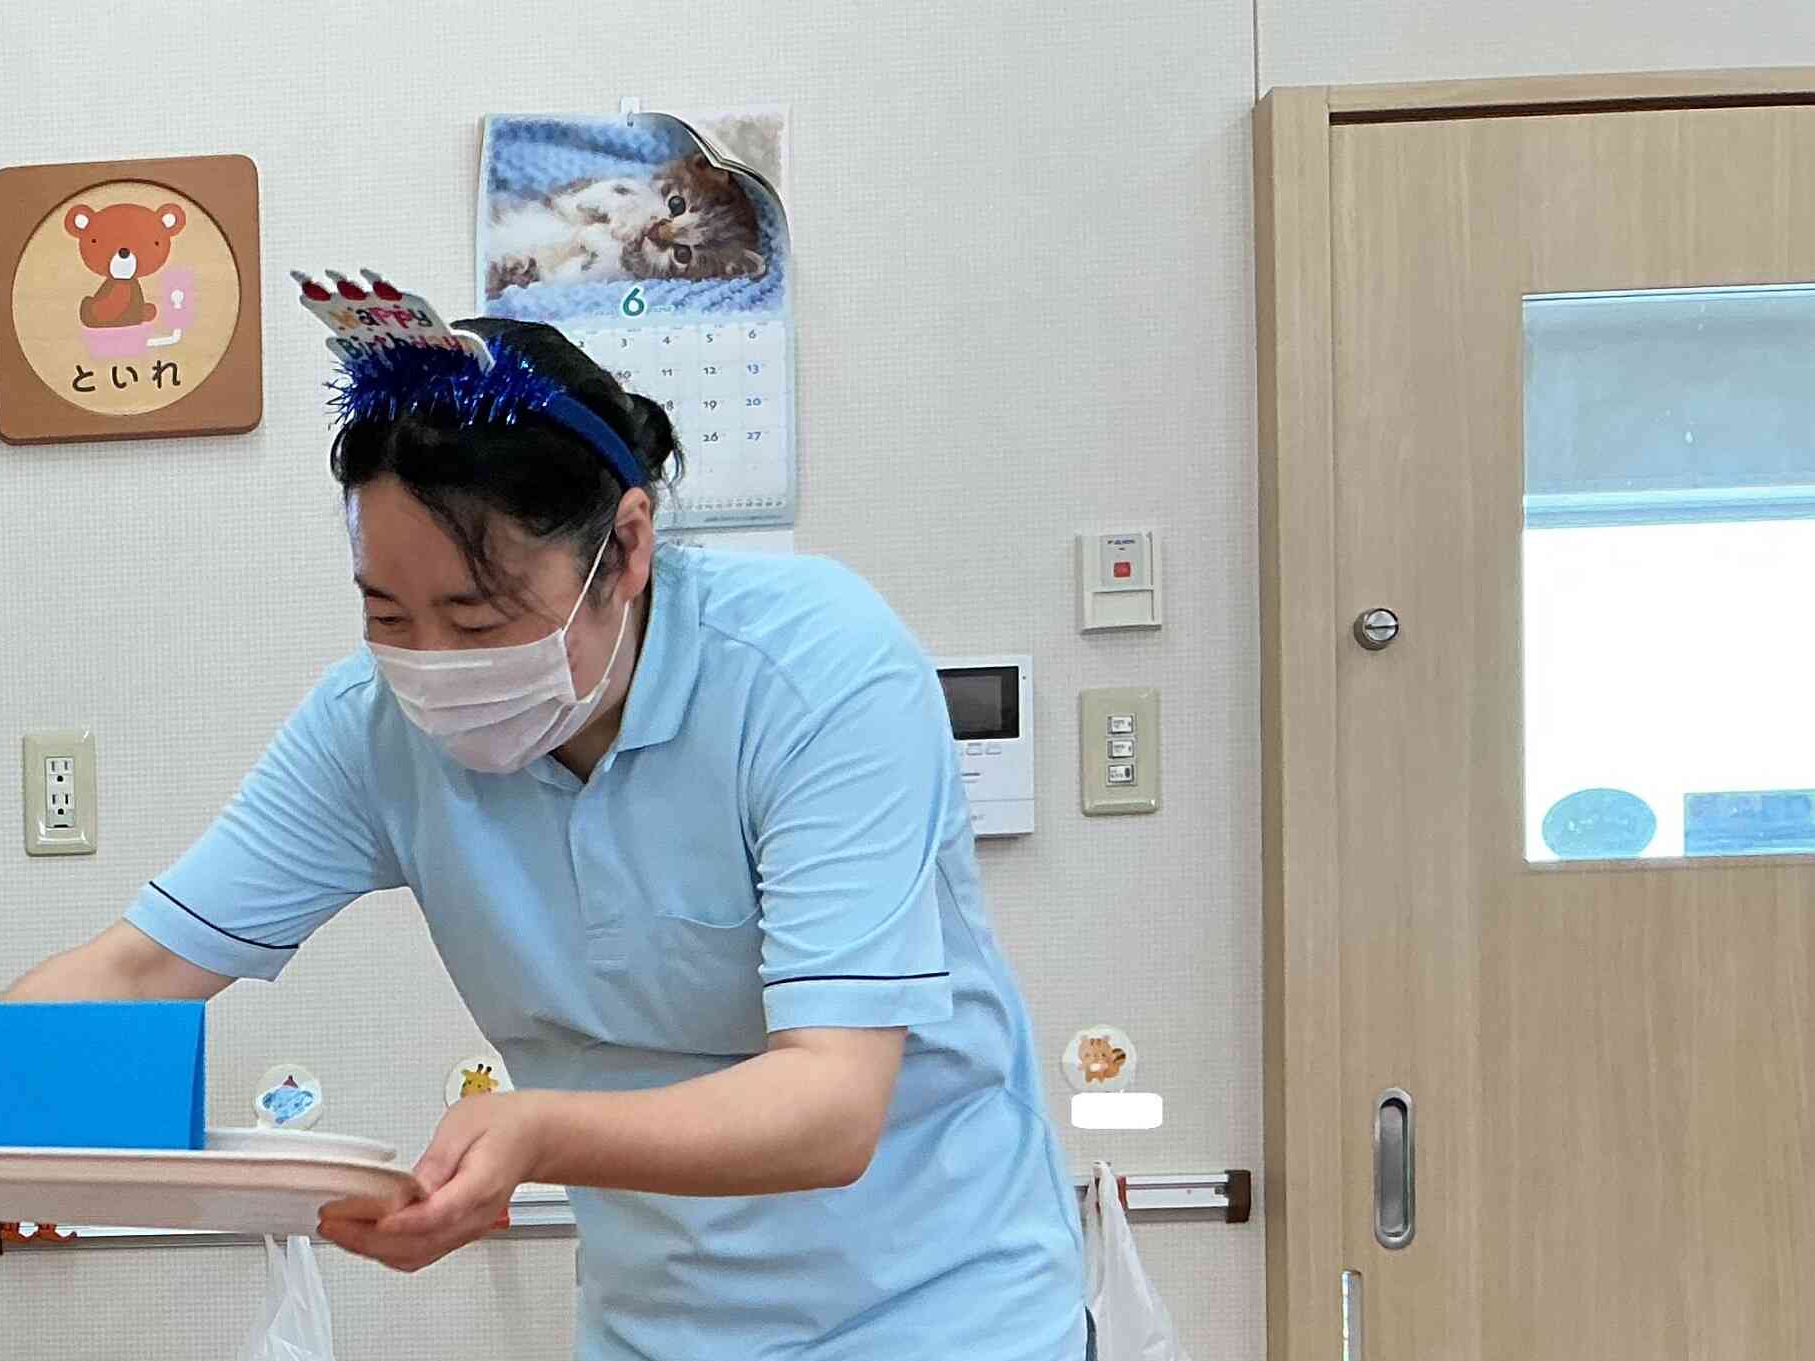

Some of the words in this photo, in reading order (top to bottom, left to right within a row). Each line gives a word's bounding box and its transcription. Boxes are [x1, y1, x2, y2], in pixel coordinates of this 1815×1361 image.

[622, 287, 646, 317] 6
[620, 338, 629, 348] 3
[662, 335, 672, 345] 4
[705, 333, 714, 344] 5
[748, 328, 757, 340] 6
[71, 359, 181, 393] といれ
[661, 367, 674, 377] 11
[703, 366, 717, 376] 12
[747, 364, 760, 375] 13
[703, 400, 718, 410] 19
[745, 398, 762, 407] 20
[702, 432, 719, 442] 26
[746, 431, 762, 441] 27
